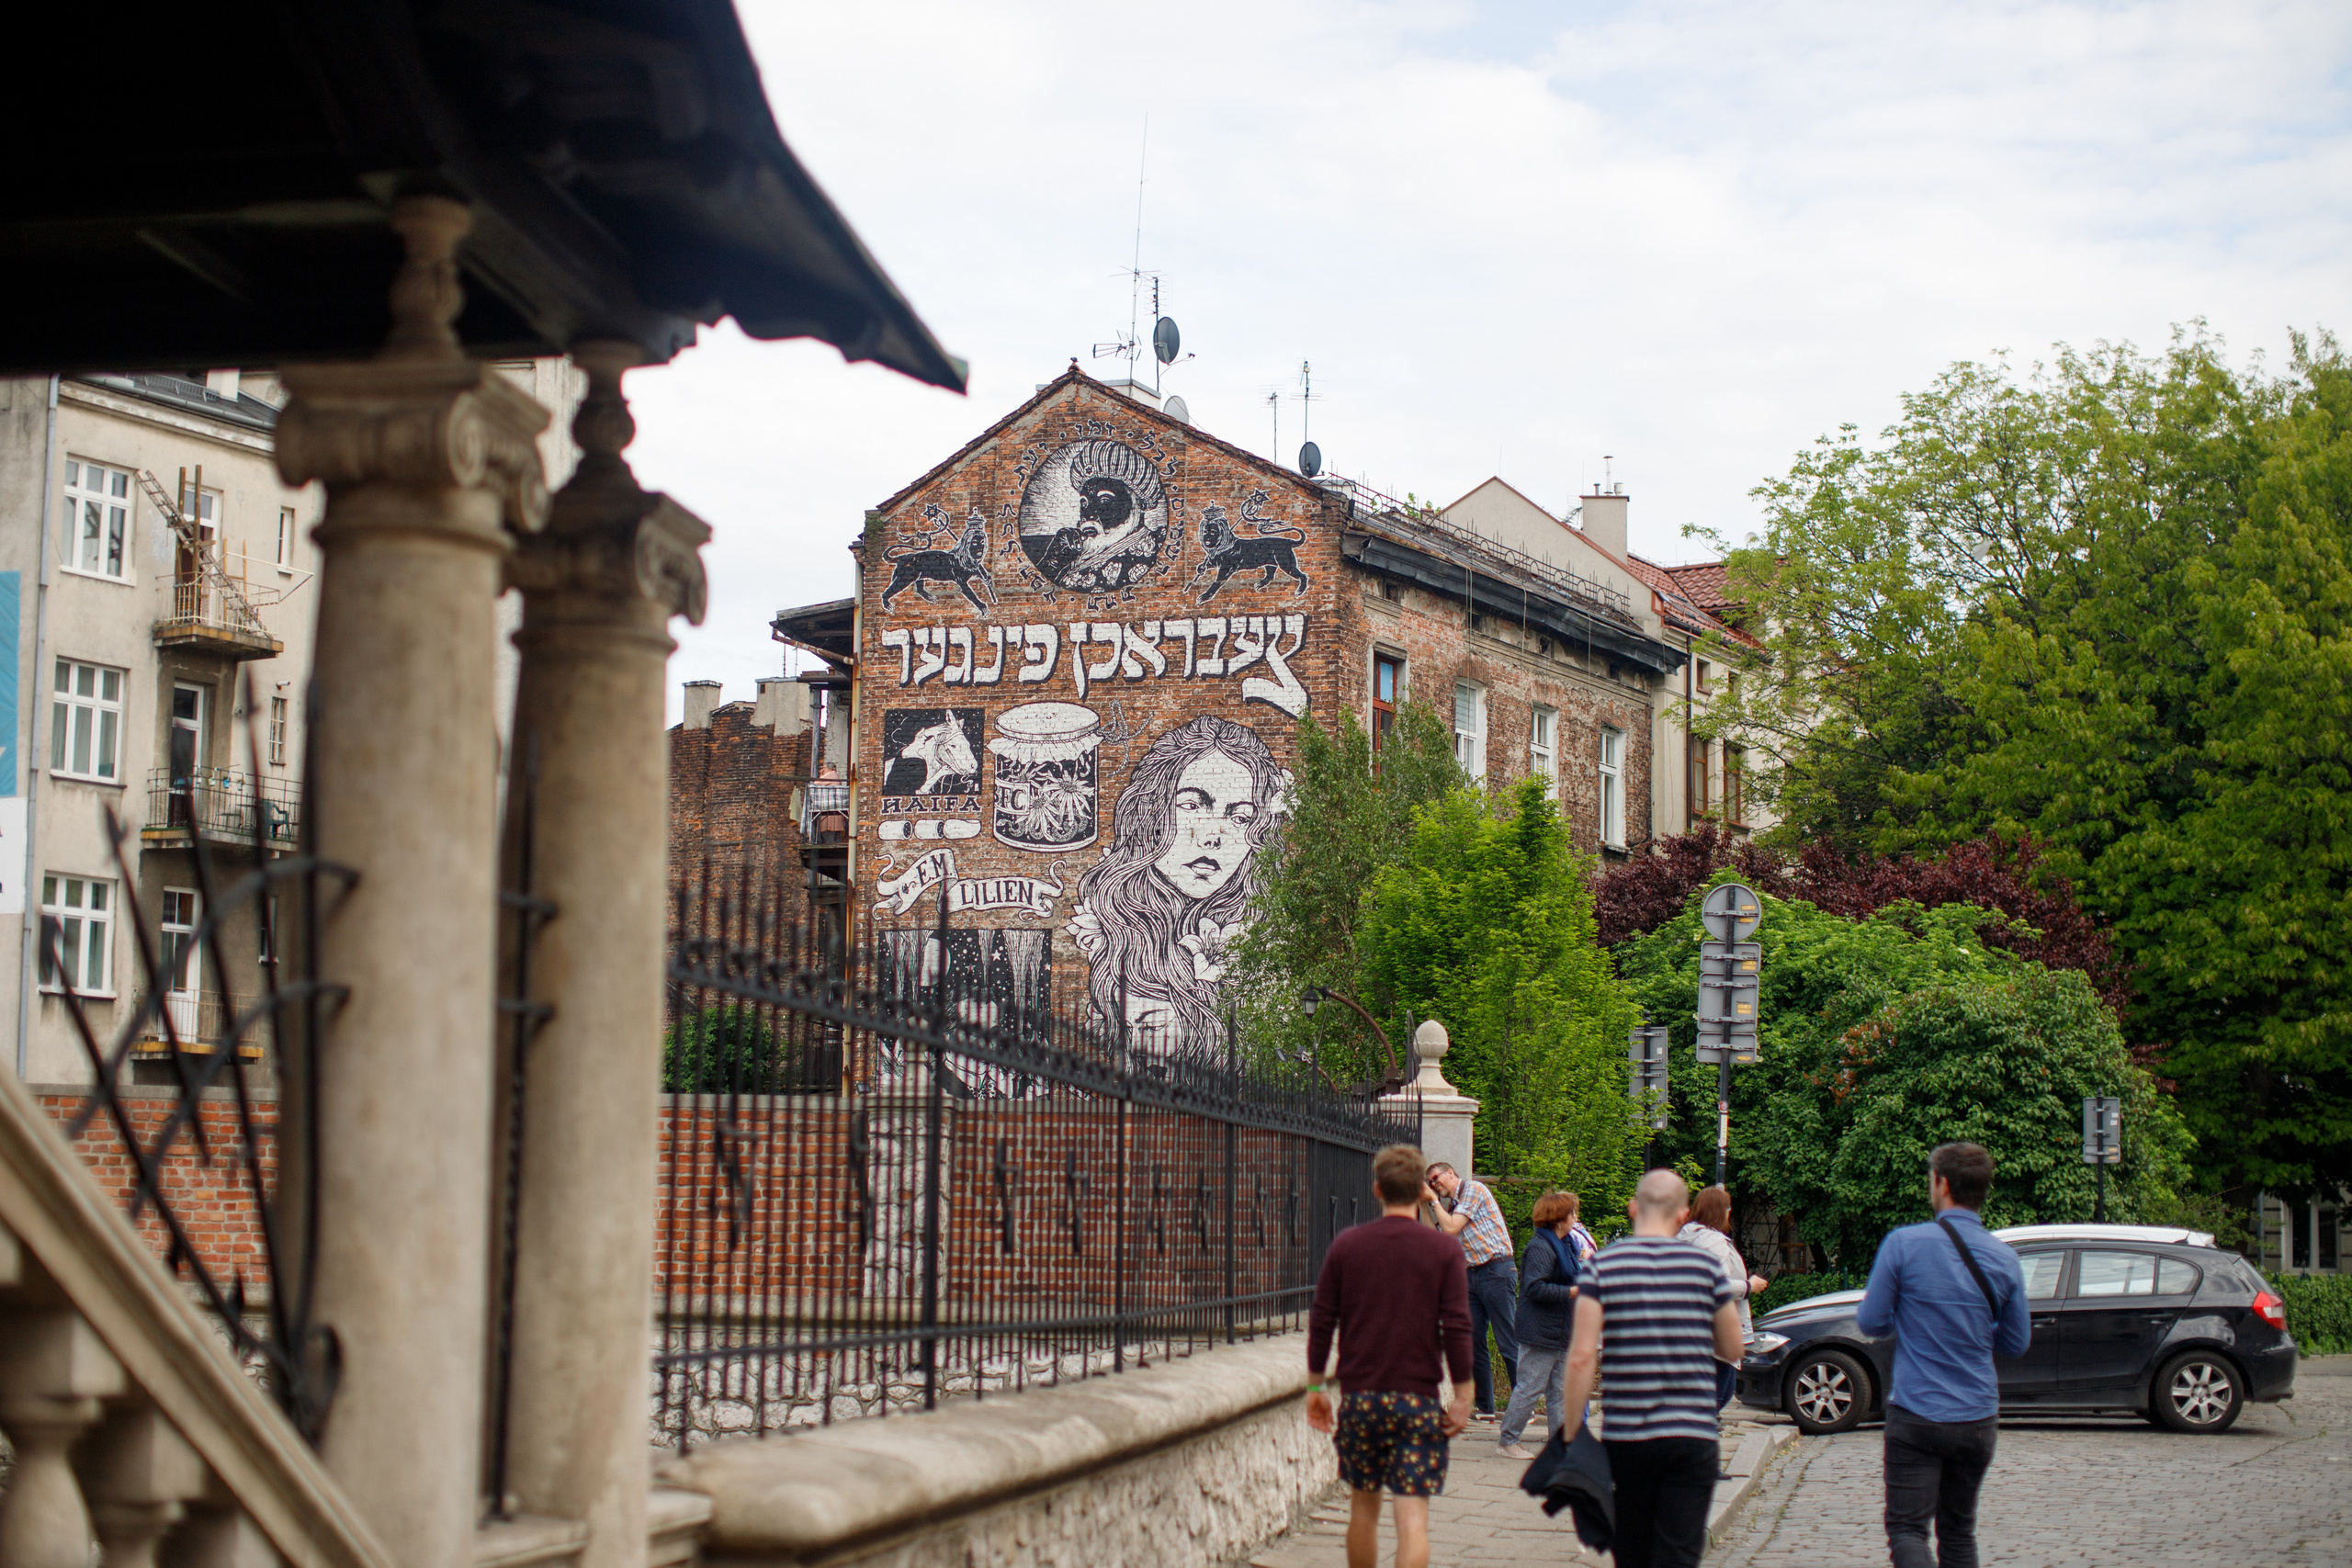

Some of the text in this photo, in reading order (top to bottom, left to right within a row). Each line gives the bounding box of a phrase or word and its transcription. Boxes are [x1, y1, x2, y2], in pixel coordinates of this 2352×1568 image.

[881, 621, 1061, 688] פינגער
[880, 795, 982, 816] HAIFA
[960, 880, 1035, 907] LILIEN
